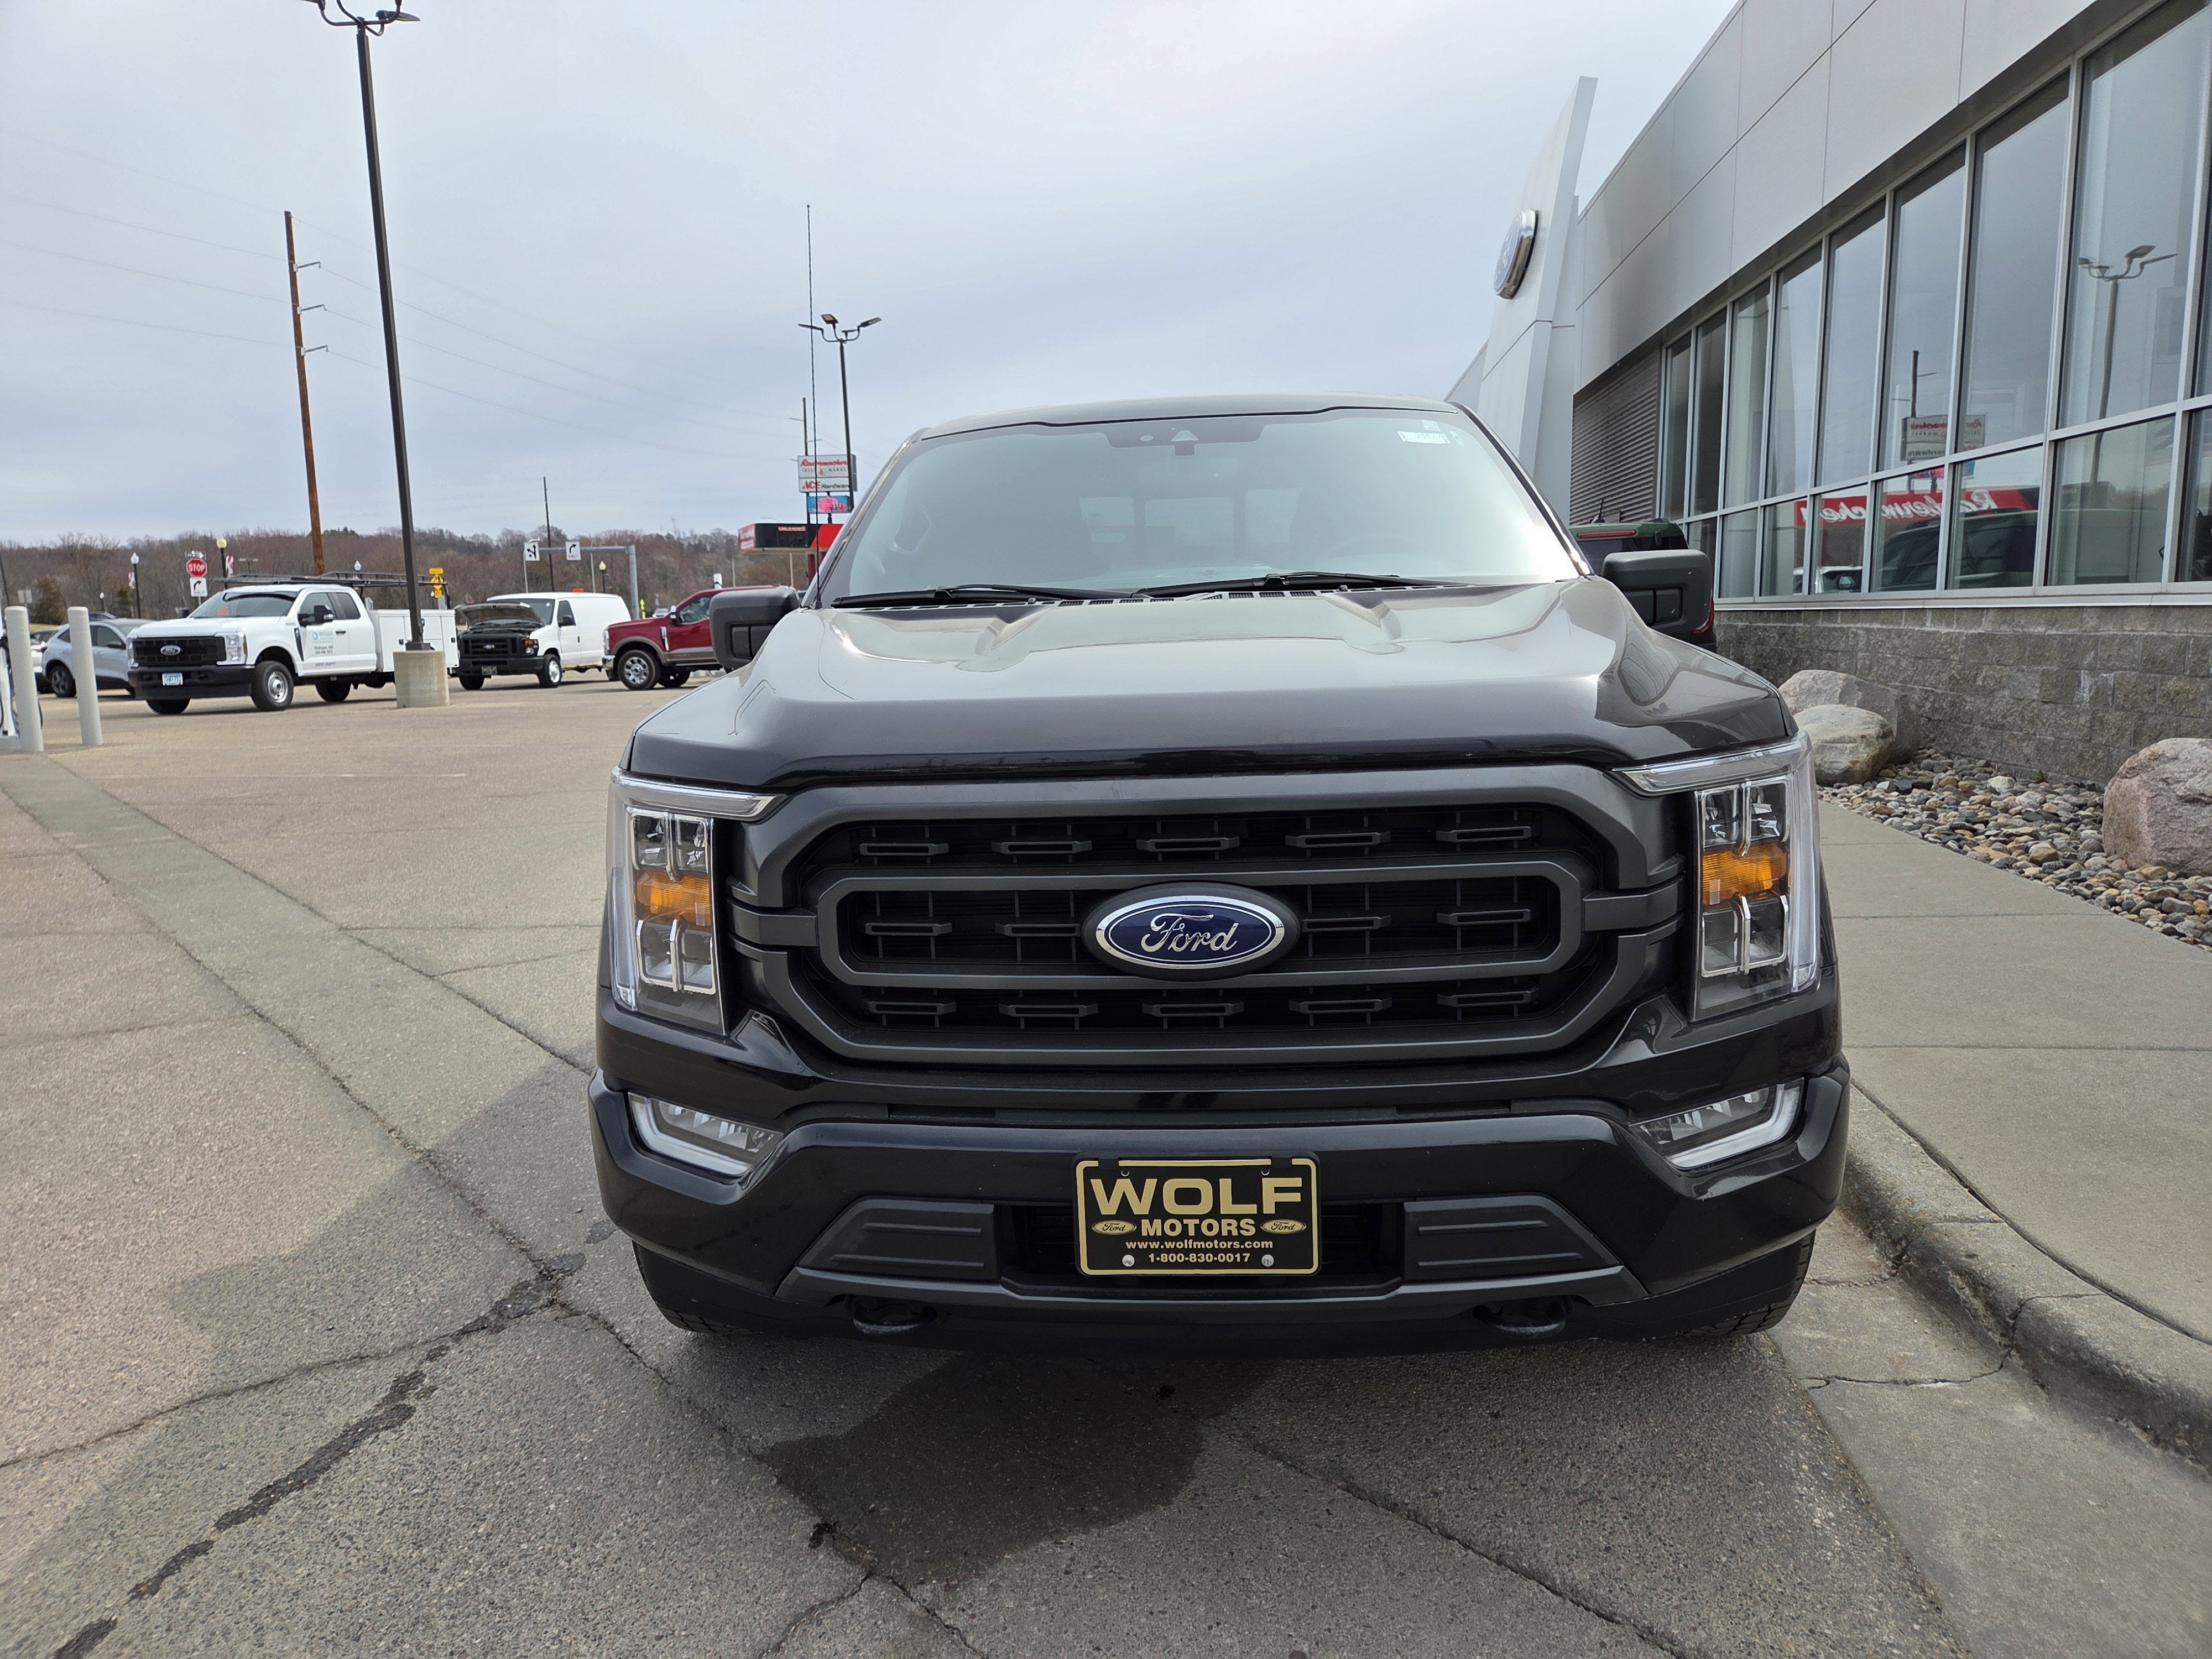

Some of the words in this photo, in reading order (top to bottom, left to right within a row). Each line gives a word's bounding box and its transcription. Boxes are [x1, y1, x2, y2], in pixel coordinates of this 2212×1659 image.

[801, 481, 821, 489] ACE
[189, 563, 205, 572] STOP
[1141, 913, 1239, 952] Ford
[1090, 1177, 1302, 1215] WOLF
[1141, 1218, 1256, 1237] MOTORS
[1271, 1222, 1295, 1230] Ford
[1126, 1239, 1273, 1249] www.wolfmotors.com
[1148, 1253, 1251, 1263] 1-800-830-0017
